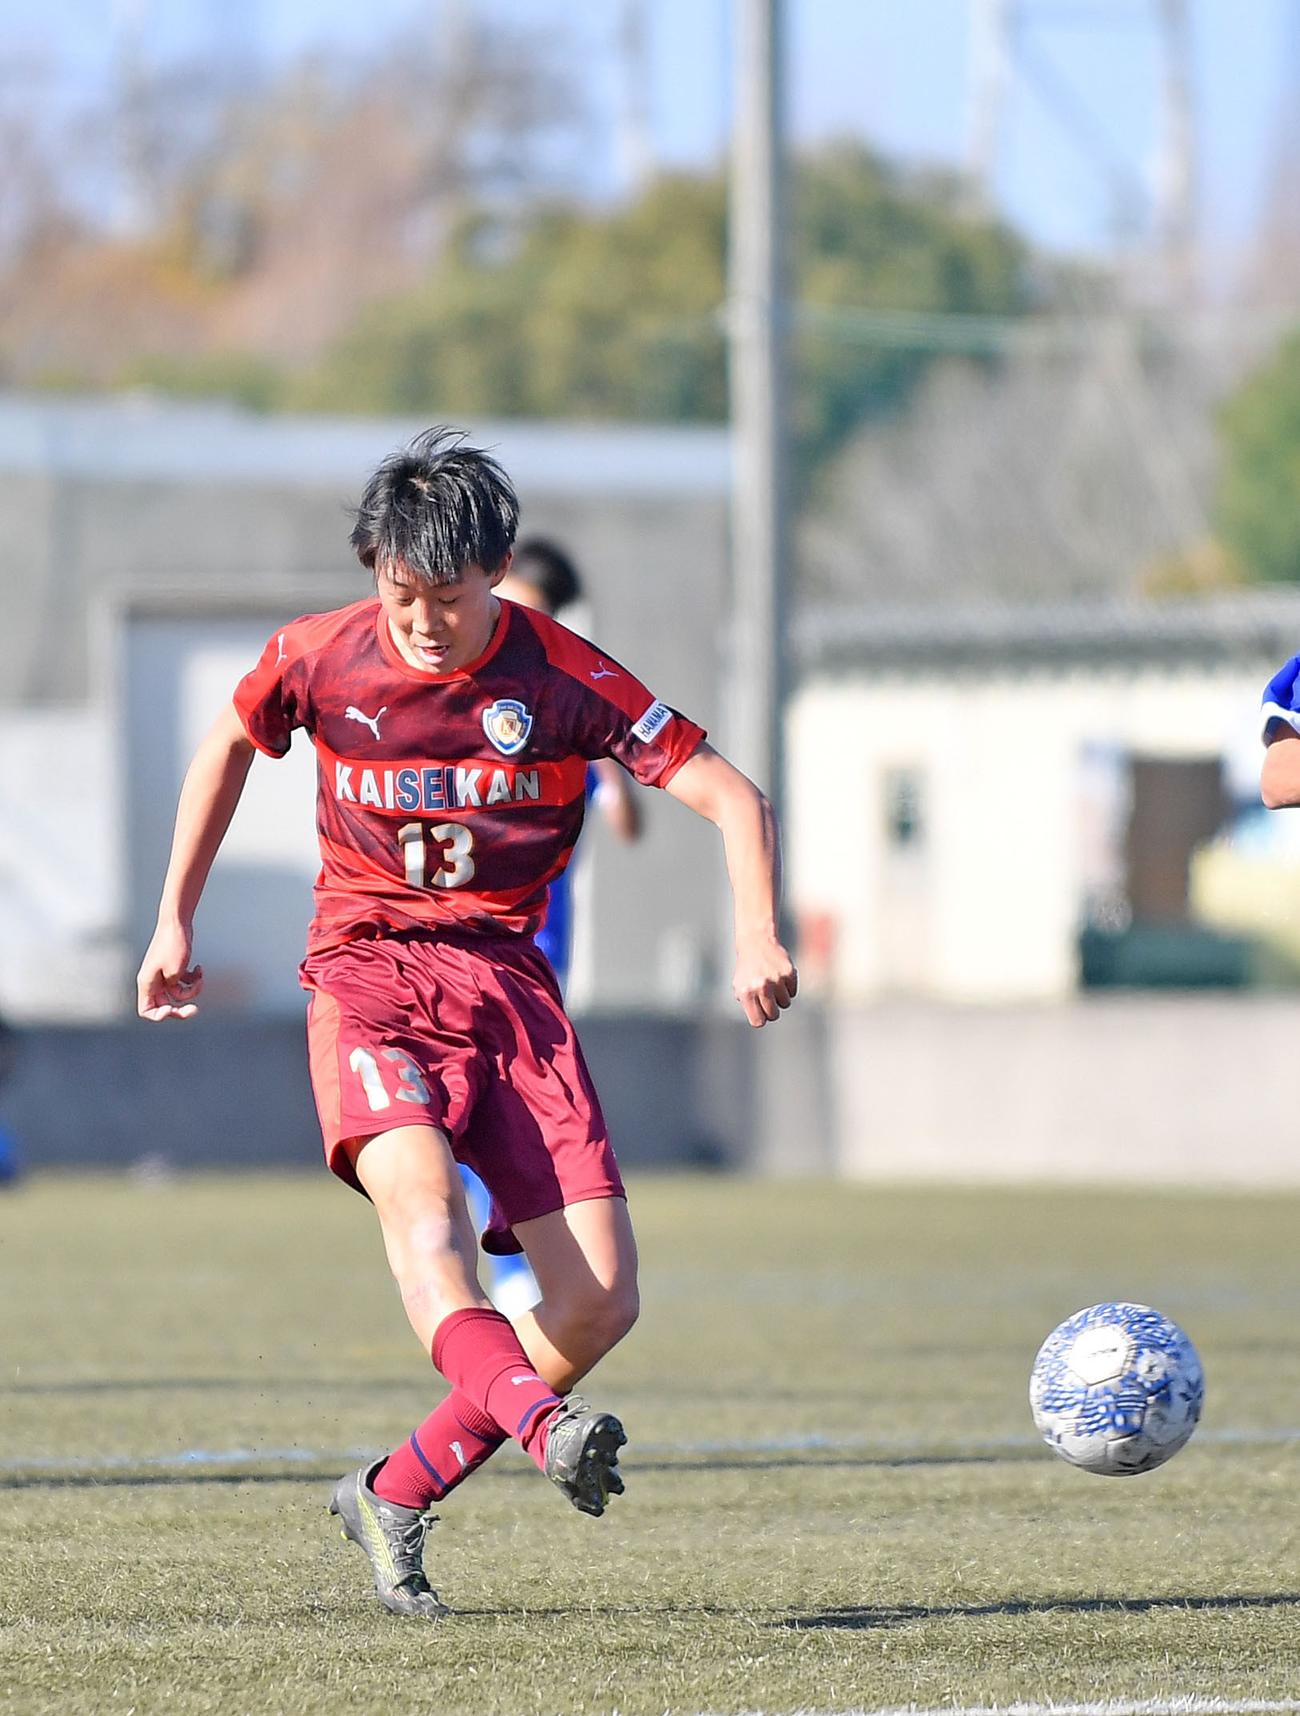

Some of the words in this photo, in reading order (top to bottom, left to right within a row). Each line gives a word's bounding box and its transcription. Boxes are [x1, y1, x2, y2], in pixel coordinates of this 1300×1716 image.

[335, 761, 541, 811] KAISEIKAN
[397, 822, 475, 889] 13
[349, 1046, 430, 1111] 13
